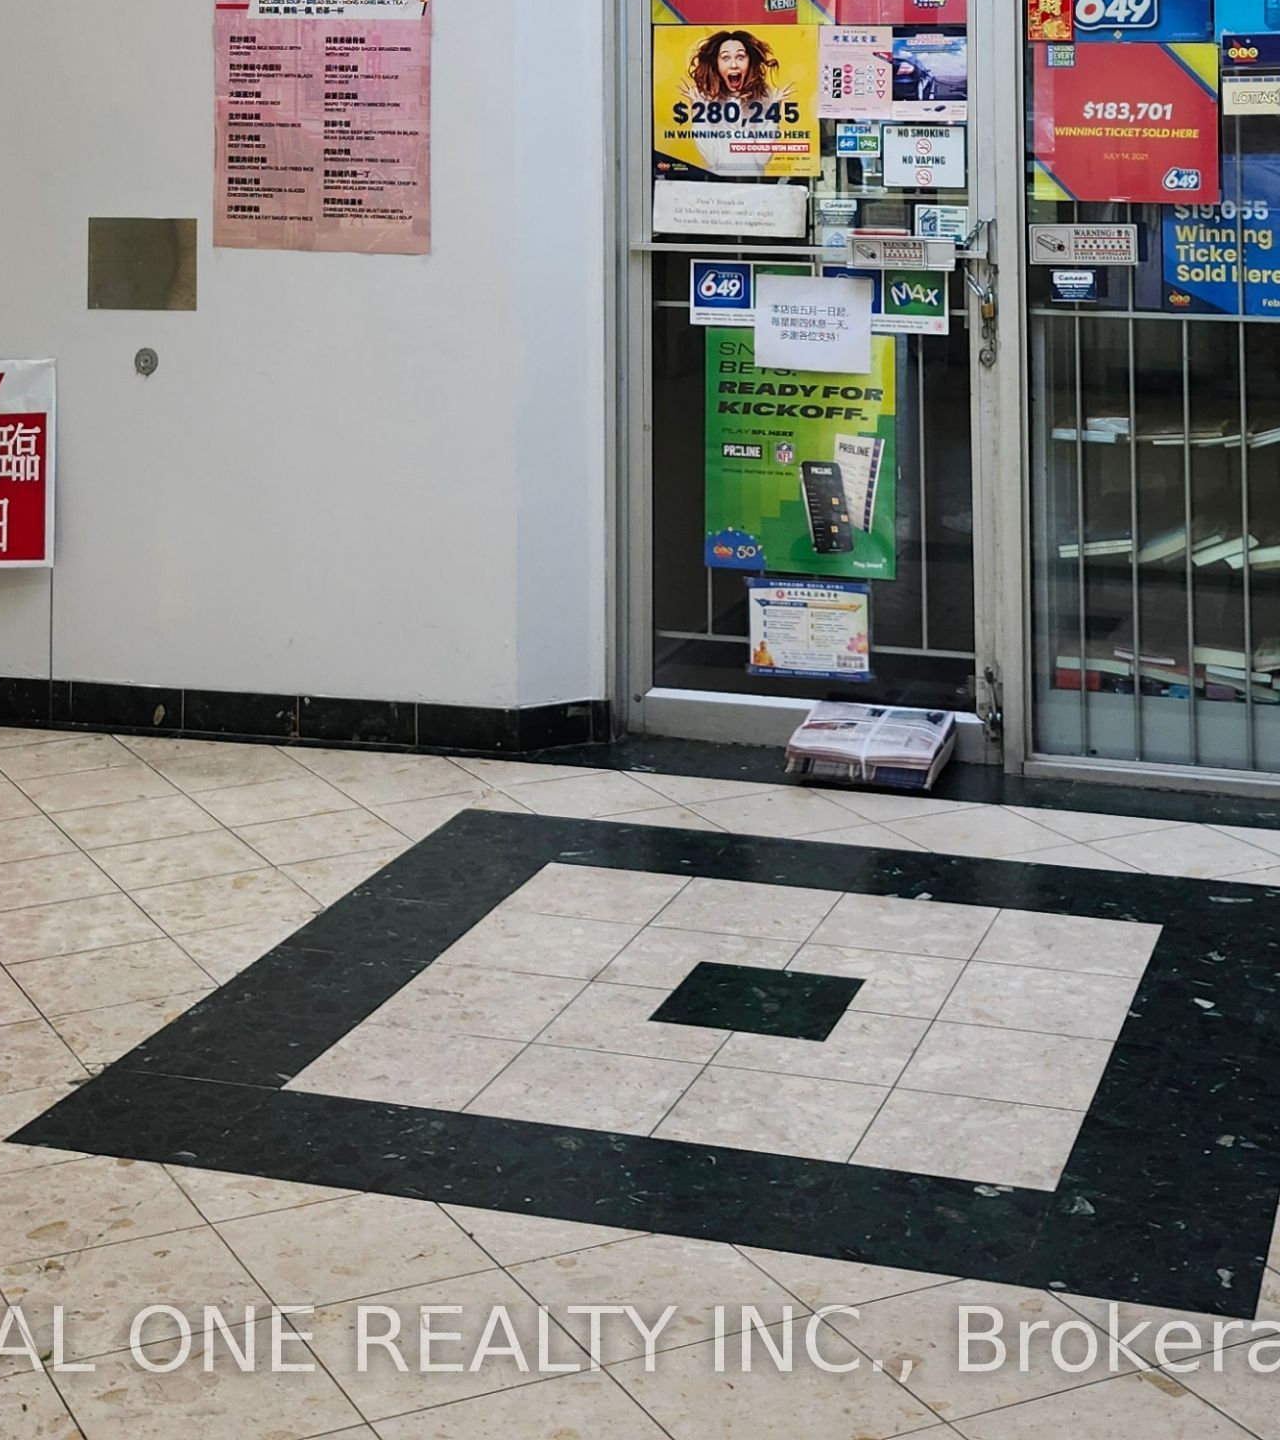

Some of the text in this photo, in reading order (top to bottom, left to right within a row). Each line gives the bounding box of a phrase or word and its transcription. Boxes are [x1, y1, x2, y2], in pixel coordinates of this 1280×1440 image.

[672, 101, 800, 127] $280,245
[1083, 101, 1173, 124] $183,701
[664, 130, 811, 140] IN WINNINGS CLAIMED HERE
[844, 126, 872, 135] PUSH
[897, 128, 951, 138] NO SMOKING
[902, 155, 946, 165] NO VAPING
[717, 380, 884, 402] READY FOR
[717, 400, 869, 422] KICKOFF.
